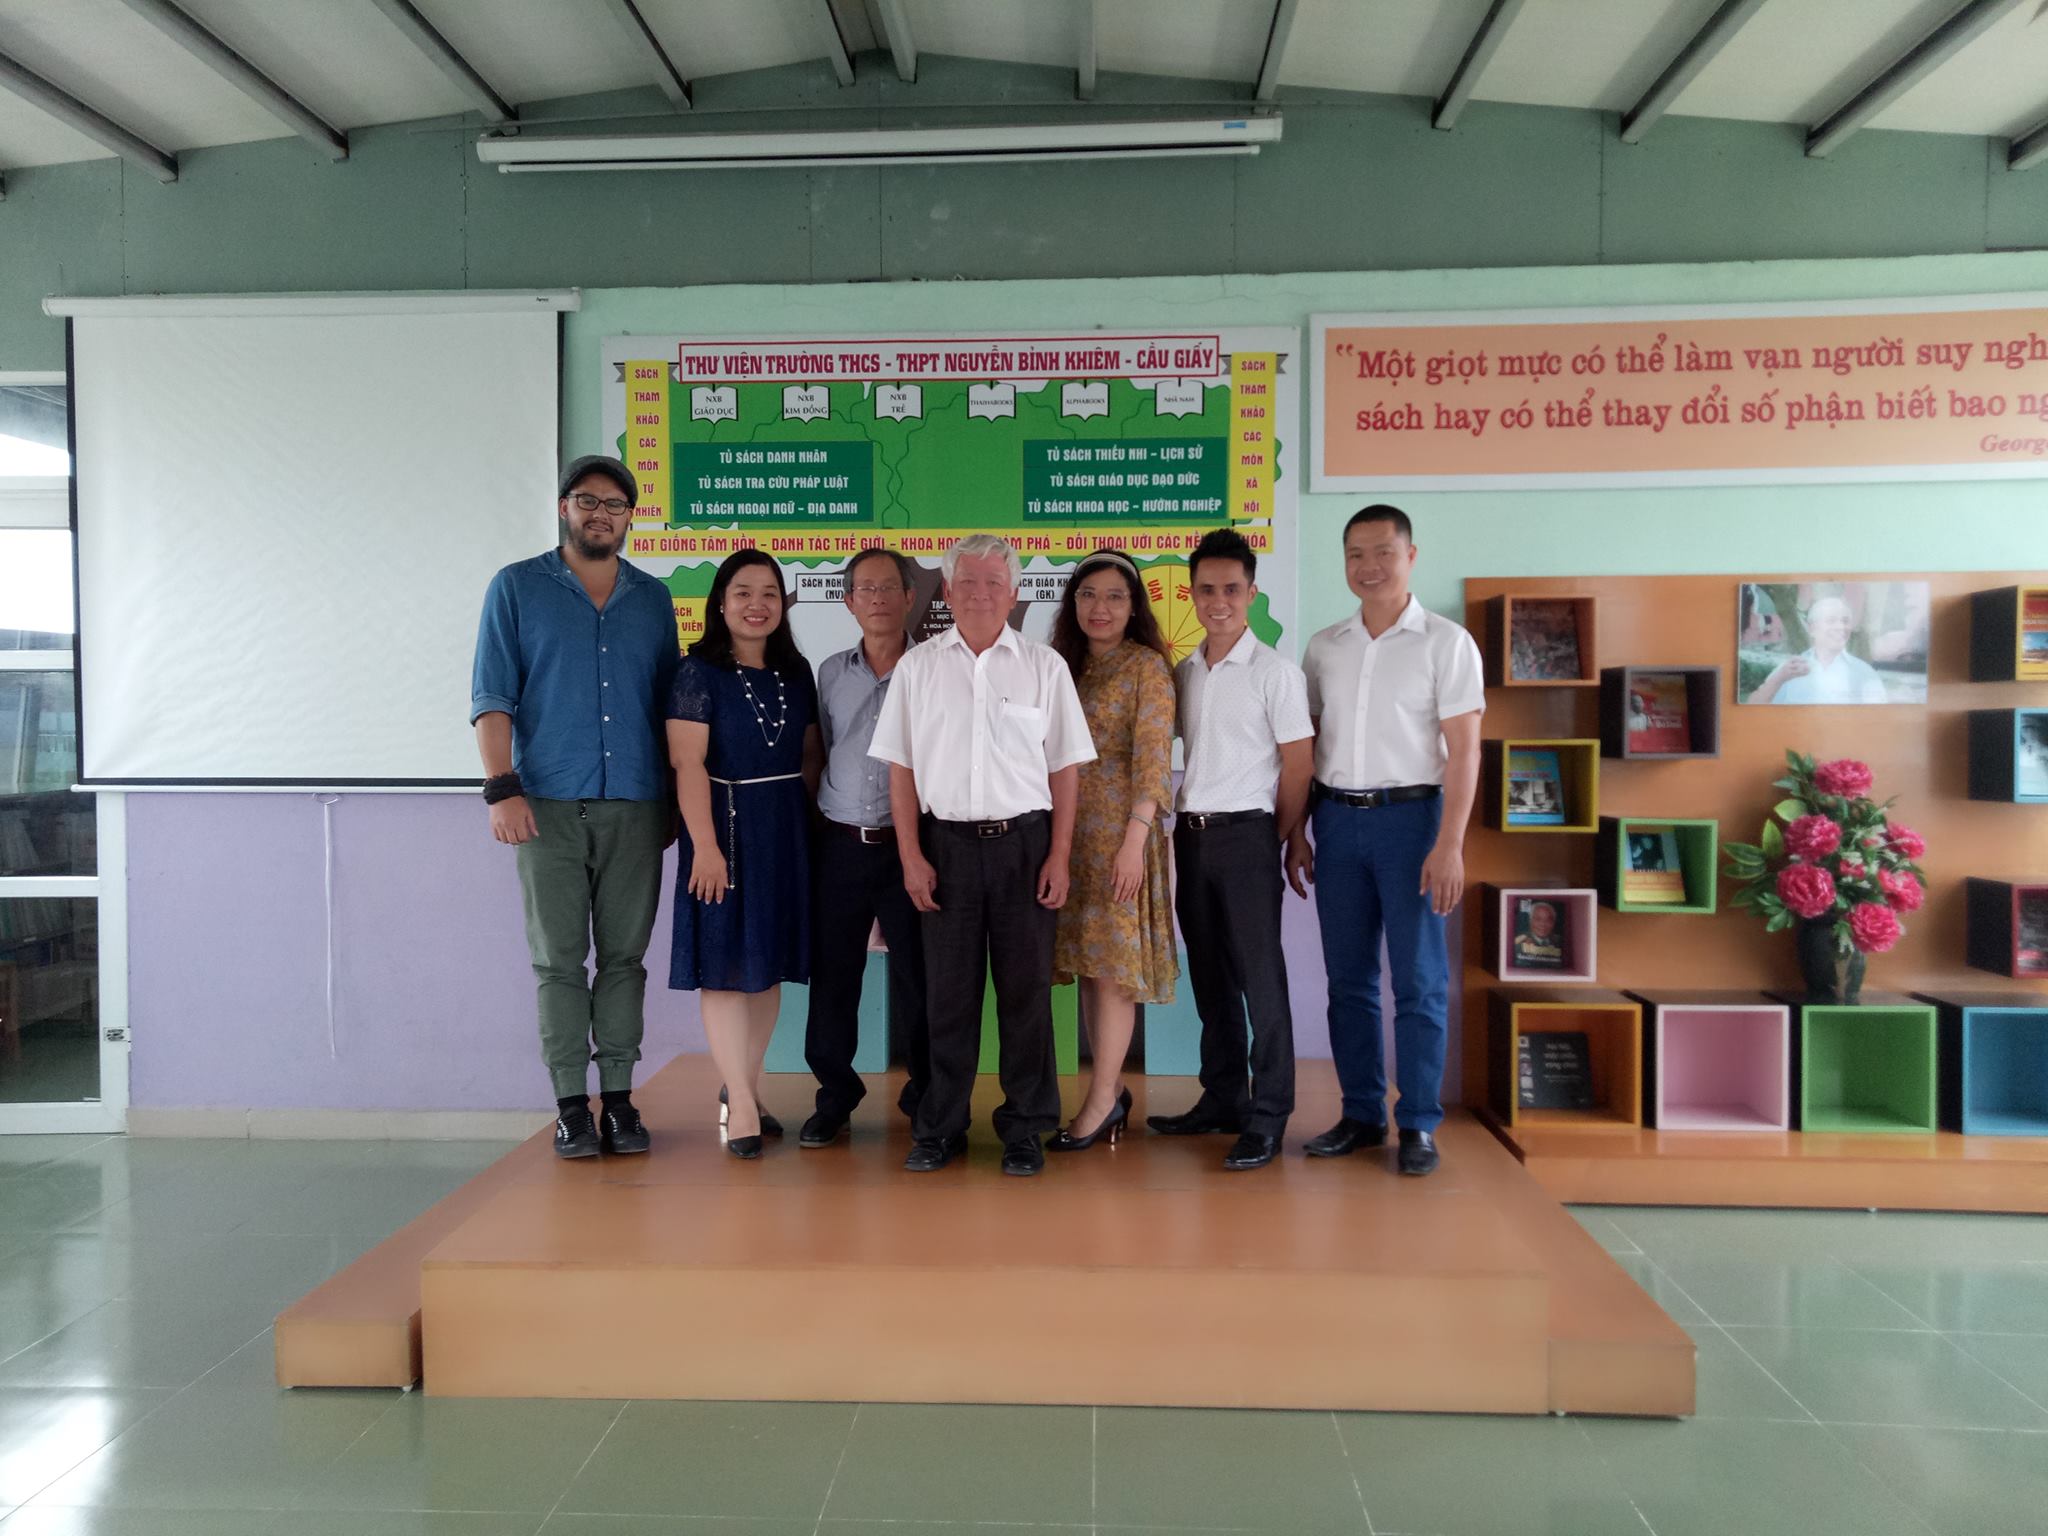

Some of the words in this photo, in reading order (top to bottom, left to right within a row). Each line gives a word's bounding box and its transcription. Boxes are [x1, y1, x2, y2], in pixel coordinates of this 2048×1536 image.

[685, 355, 720, 375] THƯ
[723, 351, 763, 378] VIỆN
[765, 351, 834, 375] TRƯỜNG
[839, 353, 880, 374] THCS
[896, 353, 940, 373] THPT
[944, 344, 1013, 373] NGUYỄN
[1064, 346, 1120, 371] KHIÊM
[1137, 342, 1169, 370] CẦU
[1174, 341, 1214, 369] GIẤY
[1426, 349, 1488, 385] giọt
[1498, 350, 1562, 383] mực
[1571, 345, 1605, 374] có
[1616, 332, 1668, 373] thể
[1674, 341, 1733, 372] làm
[1744, 347, 1801, 378] vạn
[1812, 336, 1905, 376] người
[1916, 342, 1974, 371] suy
[634, 391, 660, 402] THAM
[1240, 384, 1267, 395] THAM
[694, 407, 715, 415] GIÁO
[716, 408, 734, 416] DỤC
[803, 404, 828, 414] ĐỒNG
[1356, 401, 1424, 431] sách
[1434, 402, 1490, 437] hay
[1500, 399, 1534, 429] có
[1544, 387, 1595, 428] thể
[1602, 398, 1672, 432] thay
[1682, 384, 1730, 424] đổi
[1741, 388, 1780, 423] số
[1785, 391, 1865, 430] phận
[1876, 384, 1937, 420] biết
[1948, 389, 2006, 417] bao
[635, 412, 660, 425] KHẢO
[720, 448, 733, 463] TỦ
[736, 449, 764, 463] SÁCH
[767, 451, 796, 463] DANH
[799, 449, 828, 463] NHÂN
[1047, 446, 1060, 461] TỦ
[1063, 447, 1092, 461] SÁCH
[1095, 444, 1126, 461] THIẾU
[1128, 448, 1147, 460] NHI
[1160, 447, 1185, 462] LỊCH
[698, 474, 711, 489] TỦ
[714, 475, 742, 489] SÁCH
[746, 477, 765, 489] TRA
[793, 475, 821, 488] PHÁP
[823, 474, 849, 491] LUẬT
[1050, 472, 1063, 487] TỦ
[1066, 473, 1095, 487] SÁCH
[1098, 472, 1124, 487] GIÁO
[1127, 474, 1149, 488] DỤC
[635, 505, 662, 517] NHIÊN
[690, 500, 703, 515] TỦ
[706, 501, 734, 515] SÁCH
[738, 503, 770, 517] NGOẠI
[772, 501, 795, 515] NGỮ
[807, 502, 826, 517] ĐỊA
[829, 502, 858, 514] DANH
[1028, 498, 1041, 513] TỦ
[1044, 499, 1072, 513] SÁCH
[1076, 500, 1104, 513] KHOA
[1107, 500, 1129, 515] HỌC
[1182, 497, 1222, 513] NGHIỆP
[633, 538, 656, 554] HẠT
[660, 533, 697, 552] GIỐNG
[701, 535, 727, 552] TÂM
[731, 533, 756, 552] HỒN
[772, 538, 804, 551] DANH
[809, 535, 830, 551] TÁC
[835, 532, 856, 551] THẾ
[901, 537, 933, 551] KHOA
[1027, 534, 1050, 550] PHÁ
[1066, 532, 1087, 550] ĐỐI
[1132, 532, 1152, 549] VỚI
[1156, 533, 1180, 549] CÁC
[801, 577, 823, 588] SÁCH
[1019, 576, 1033, 588] ÁCH
[1035, 577, 1055, 588] GIÁO
[825, 589, 844, 600] (NV)
[1036, 589, 1055, 600] (GK)
